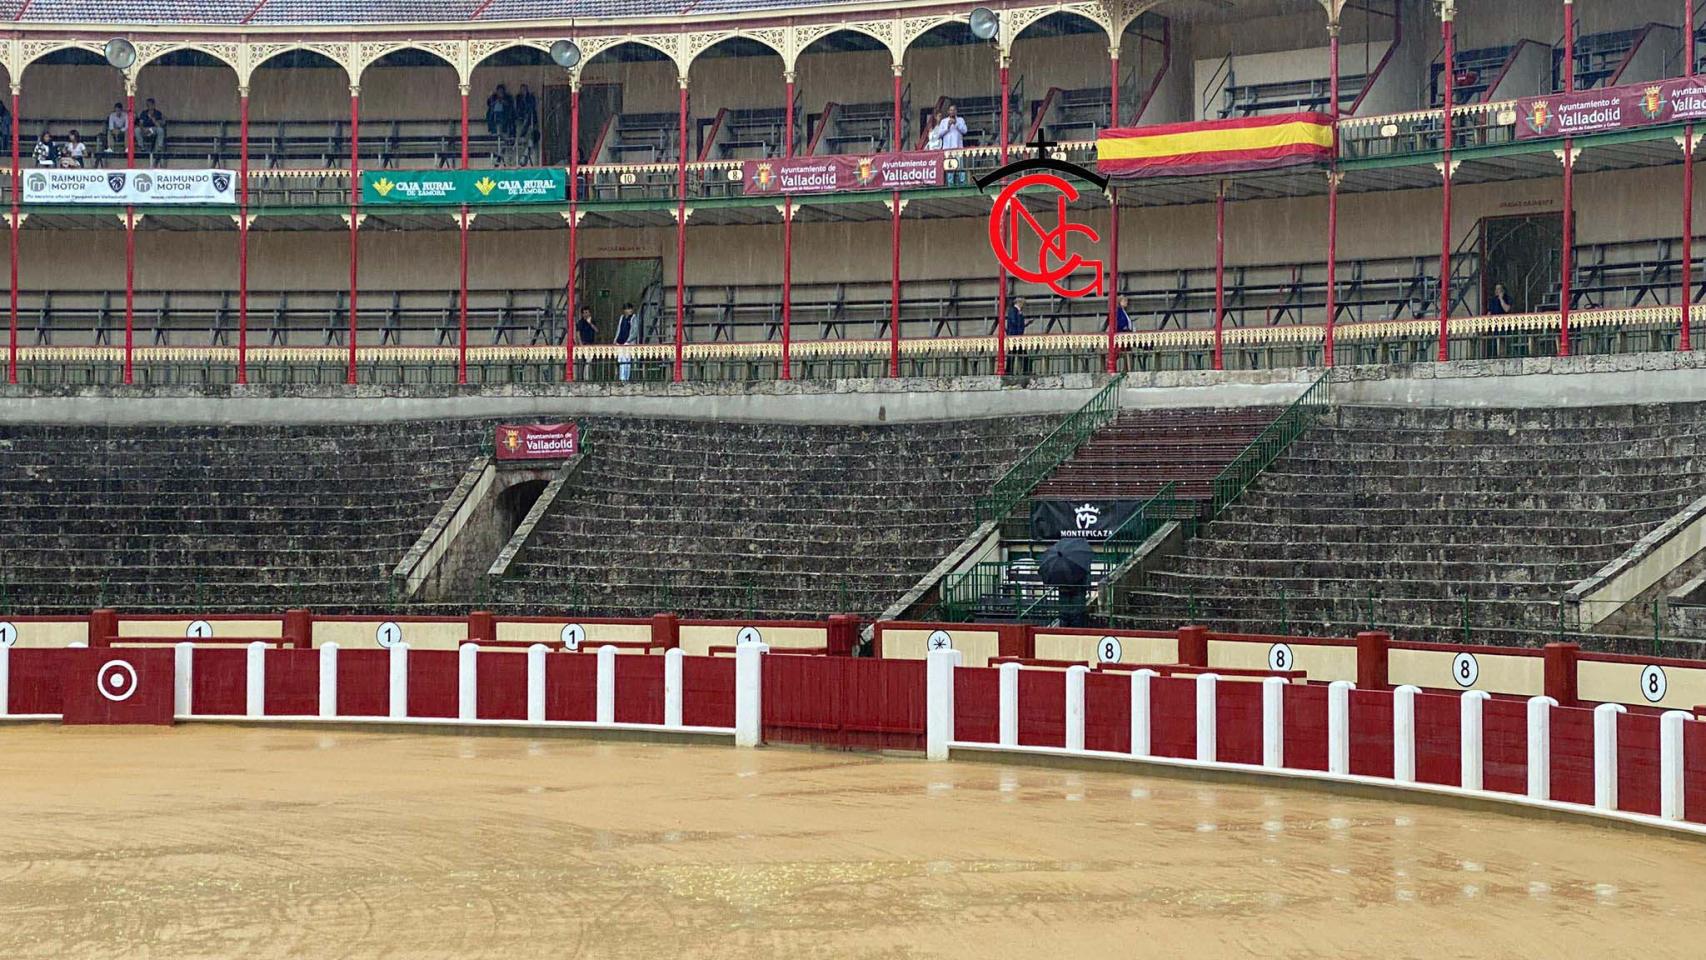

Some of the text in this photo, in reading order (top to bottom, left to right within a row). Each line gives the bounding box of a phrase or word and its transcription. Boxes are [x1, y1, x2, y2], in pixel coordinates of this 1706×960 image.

[1558, 97, 1620, 112] Ayuntamiento de
[1558, 107, 1621, 126] Valladolid
[781, 165, 826, 174] Ayuntamiento
[882, 160, 927, 169] Ayuntamiento
[51, 175, 104, 183] RAIMUNDO
[156, 175, 209, 183] RAIMUNDO
[781, 172, 837, 186] Valladolid
[882, 167, 937, 181] Valladolid
[156, 183, 191, 191] MOTOR
[396, 181, 456, 191] CAJA RURAL
[497, 180, 556, 190] CAJA RURAL
[526, 439, 573, 450] Valladolid
[0, 627, 6, 642] 1
[194, 626, 202, 638] 1
[384, 627, 391, 643] 1
[568, 629, 575, 645] 1
[1105, 642, 1114, 660] 8
[1276, 650, 1285, 668] 8
[1460, 659, 1470, 679] 8
[1649, 672, 1659, 693] 8
